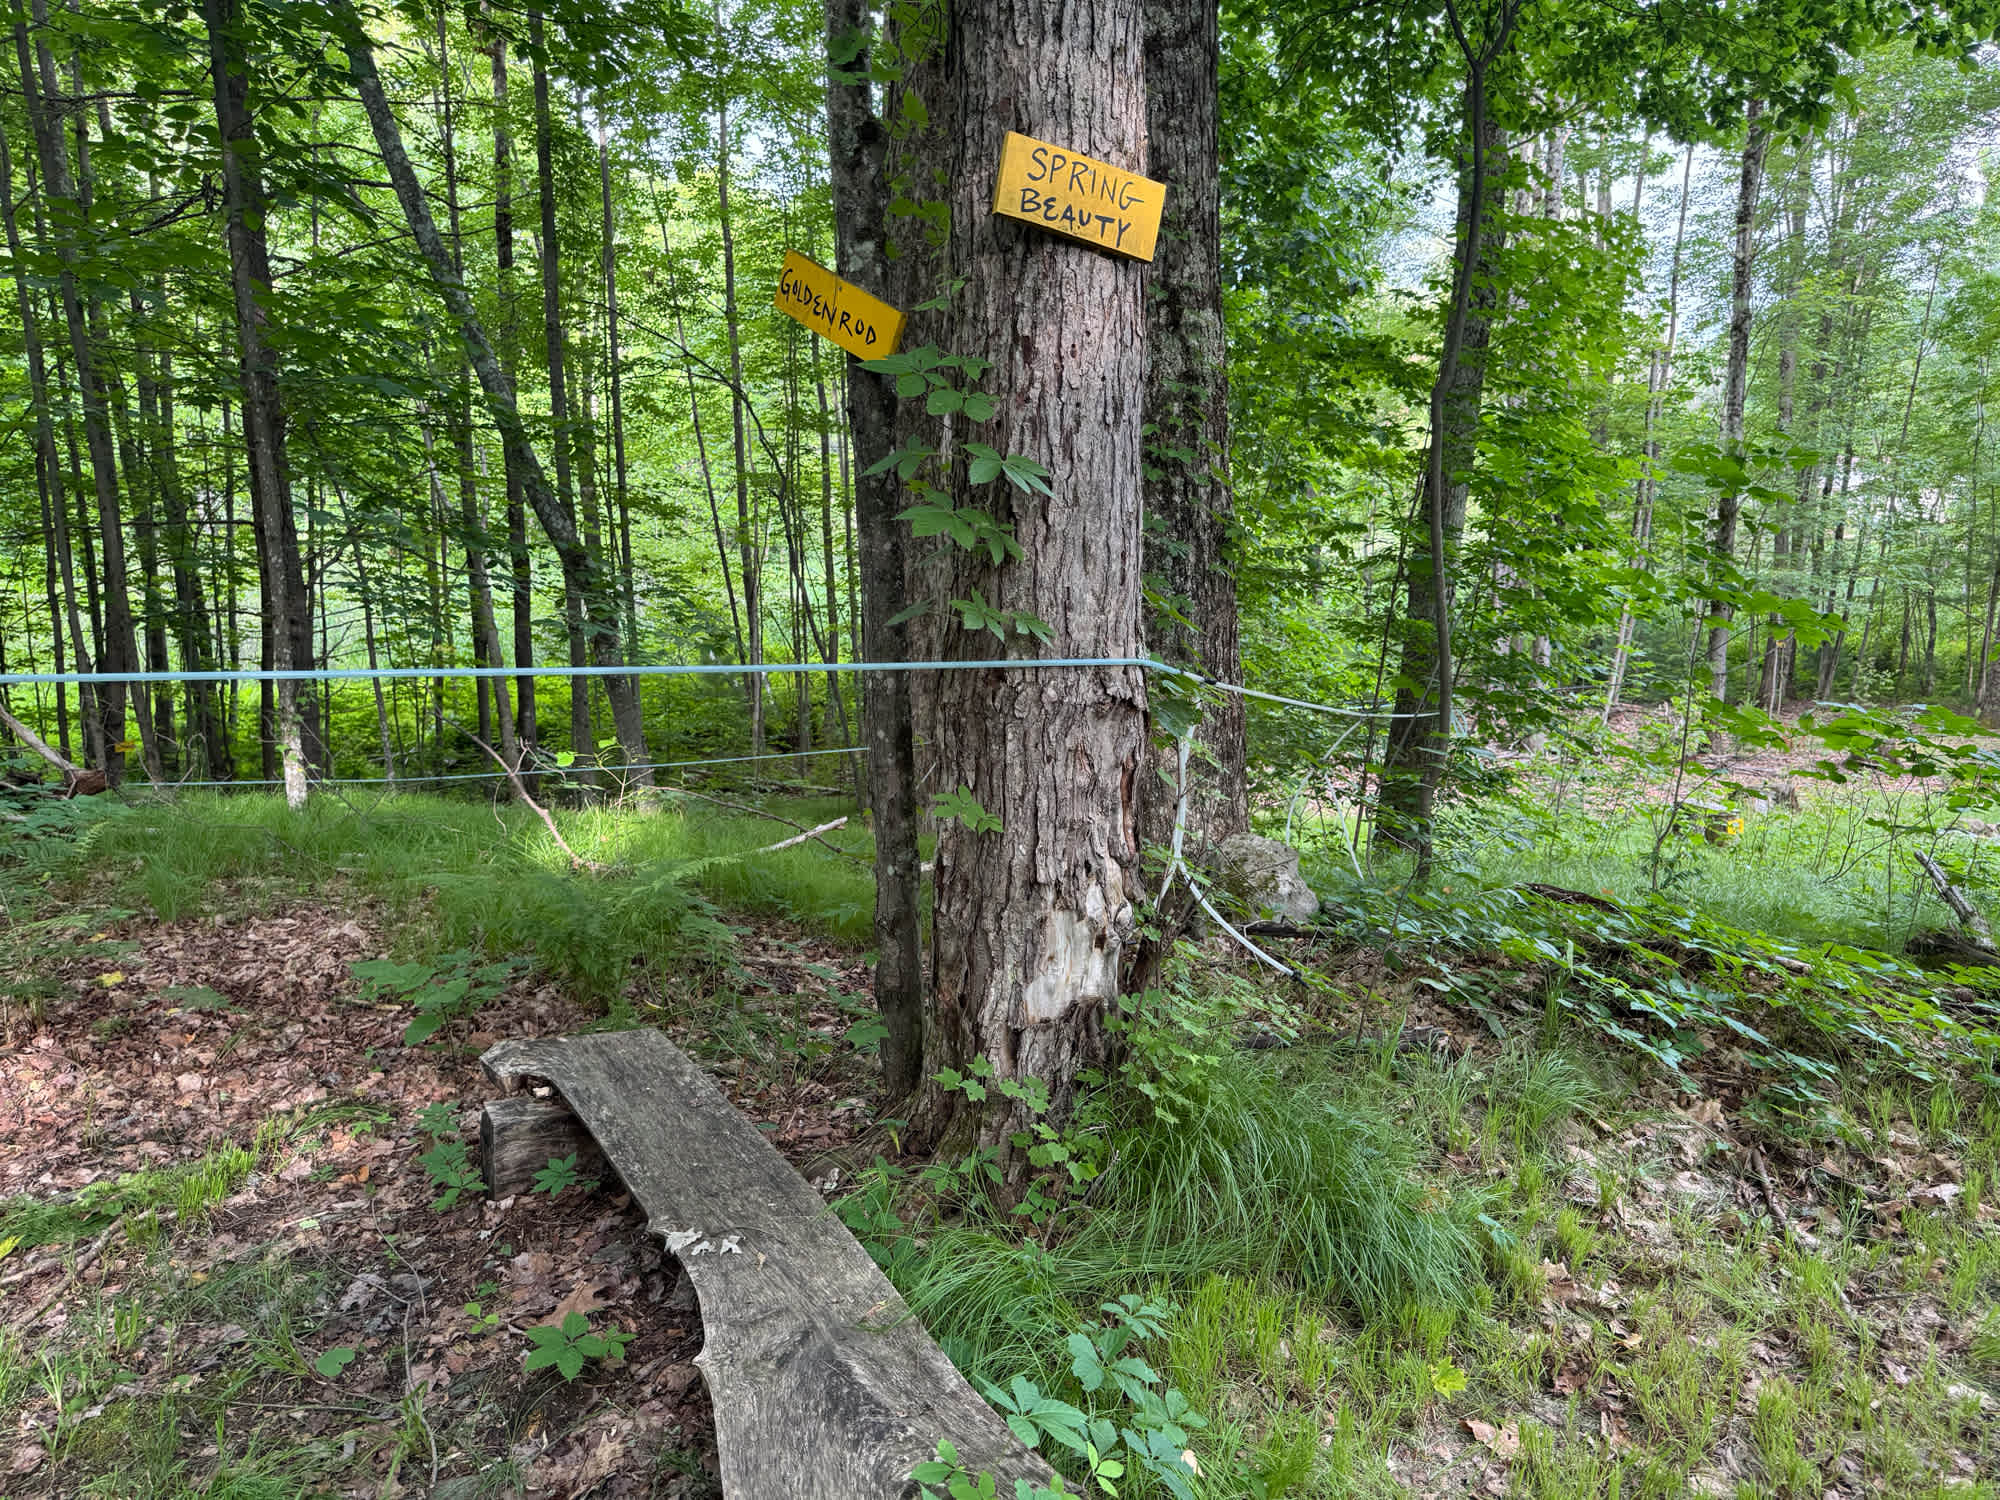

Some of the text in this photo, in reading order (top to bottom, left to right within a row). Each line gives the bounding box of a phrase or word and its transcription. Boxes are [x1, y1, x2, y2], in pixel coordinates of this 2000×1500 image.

[1027, 147, 1145, 211] SPRING
[1020, 187, 1131, 248] BEAUTY
[780, 268, 877, 345] GOLDENROD
